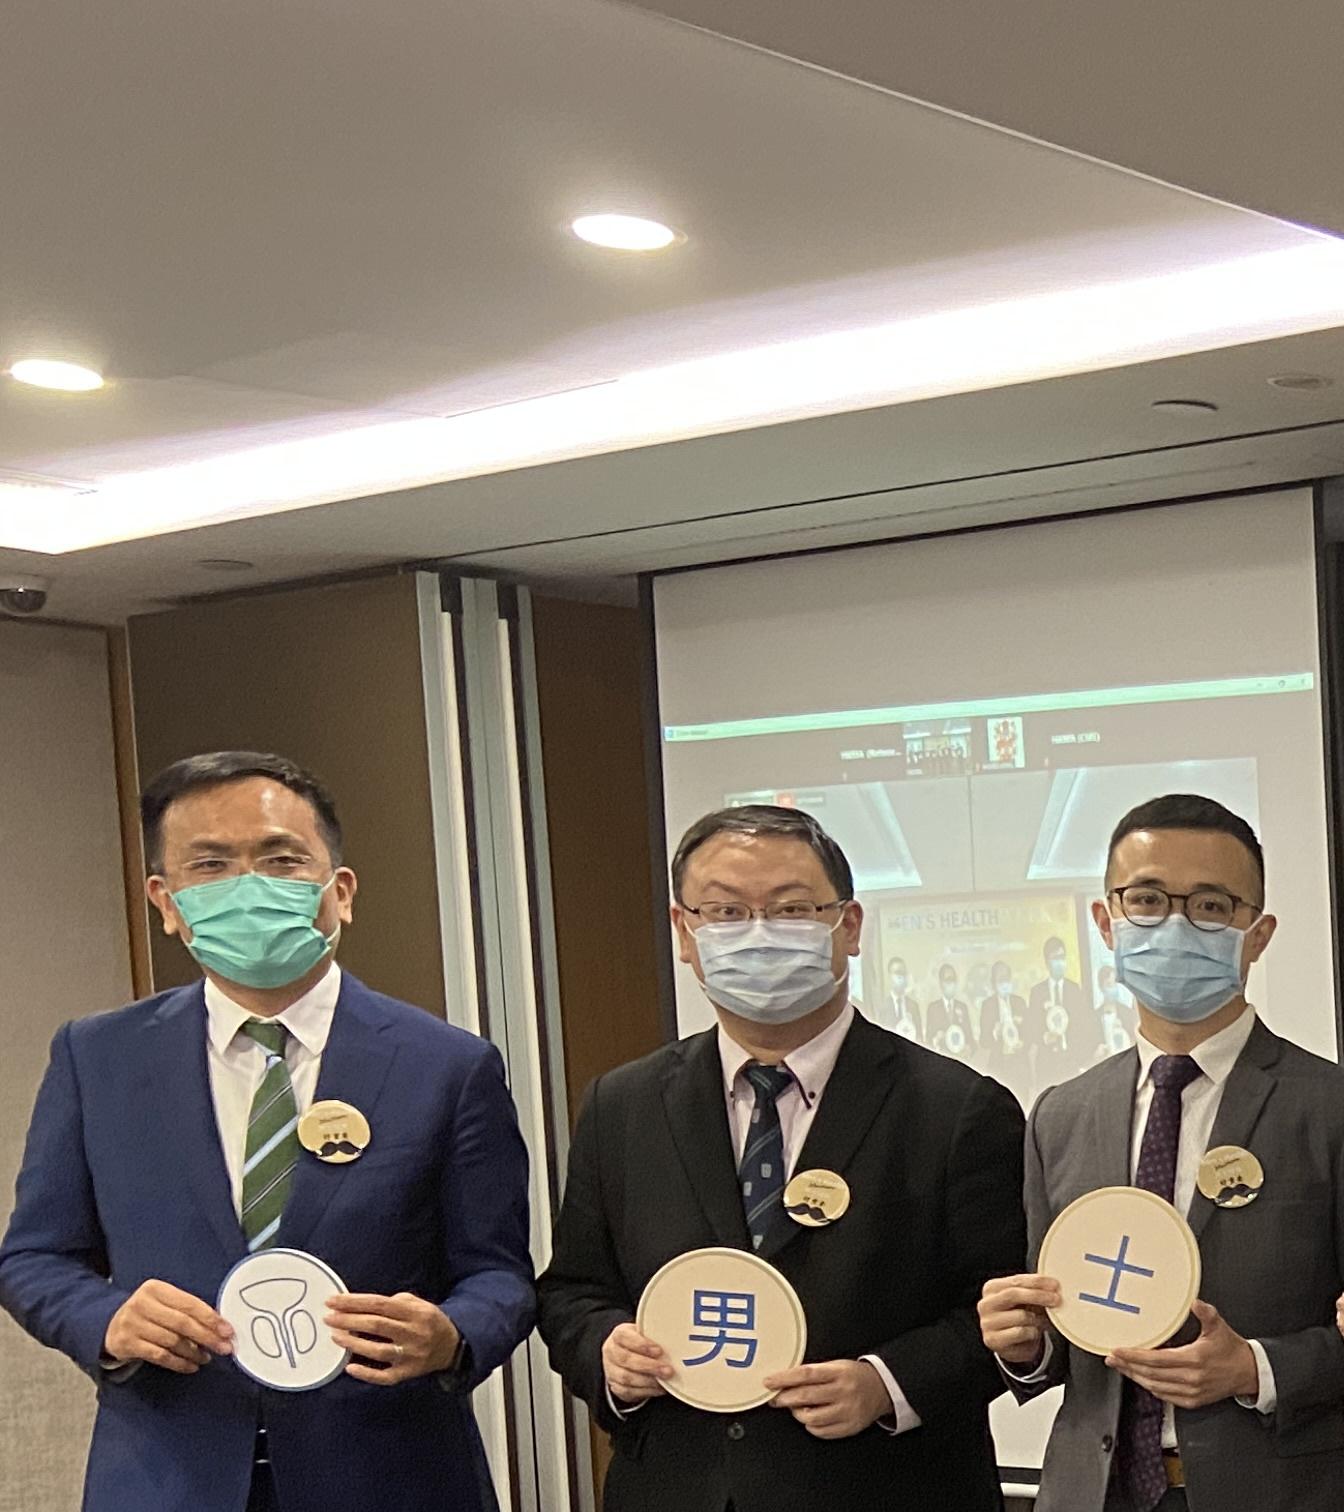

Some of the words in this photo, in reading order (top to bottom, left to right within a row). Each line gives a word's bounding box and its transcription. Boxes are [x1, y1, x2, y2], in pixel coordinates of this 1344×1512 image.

[940, 908, 999, 929] HEALTH
[1078, 1234, 1155, 1315] 士
[682, 1288, 760, 1368] 男
